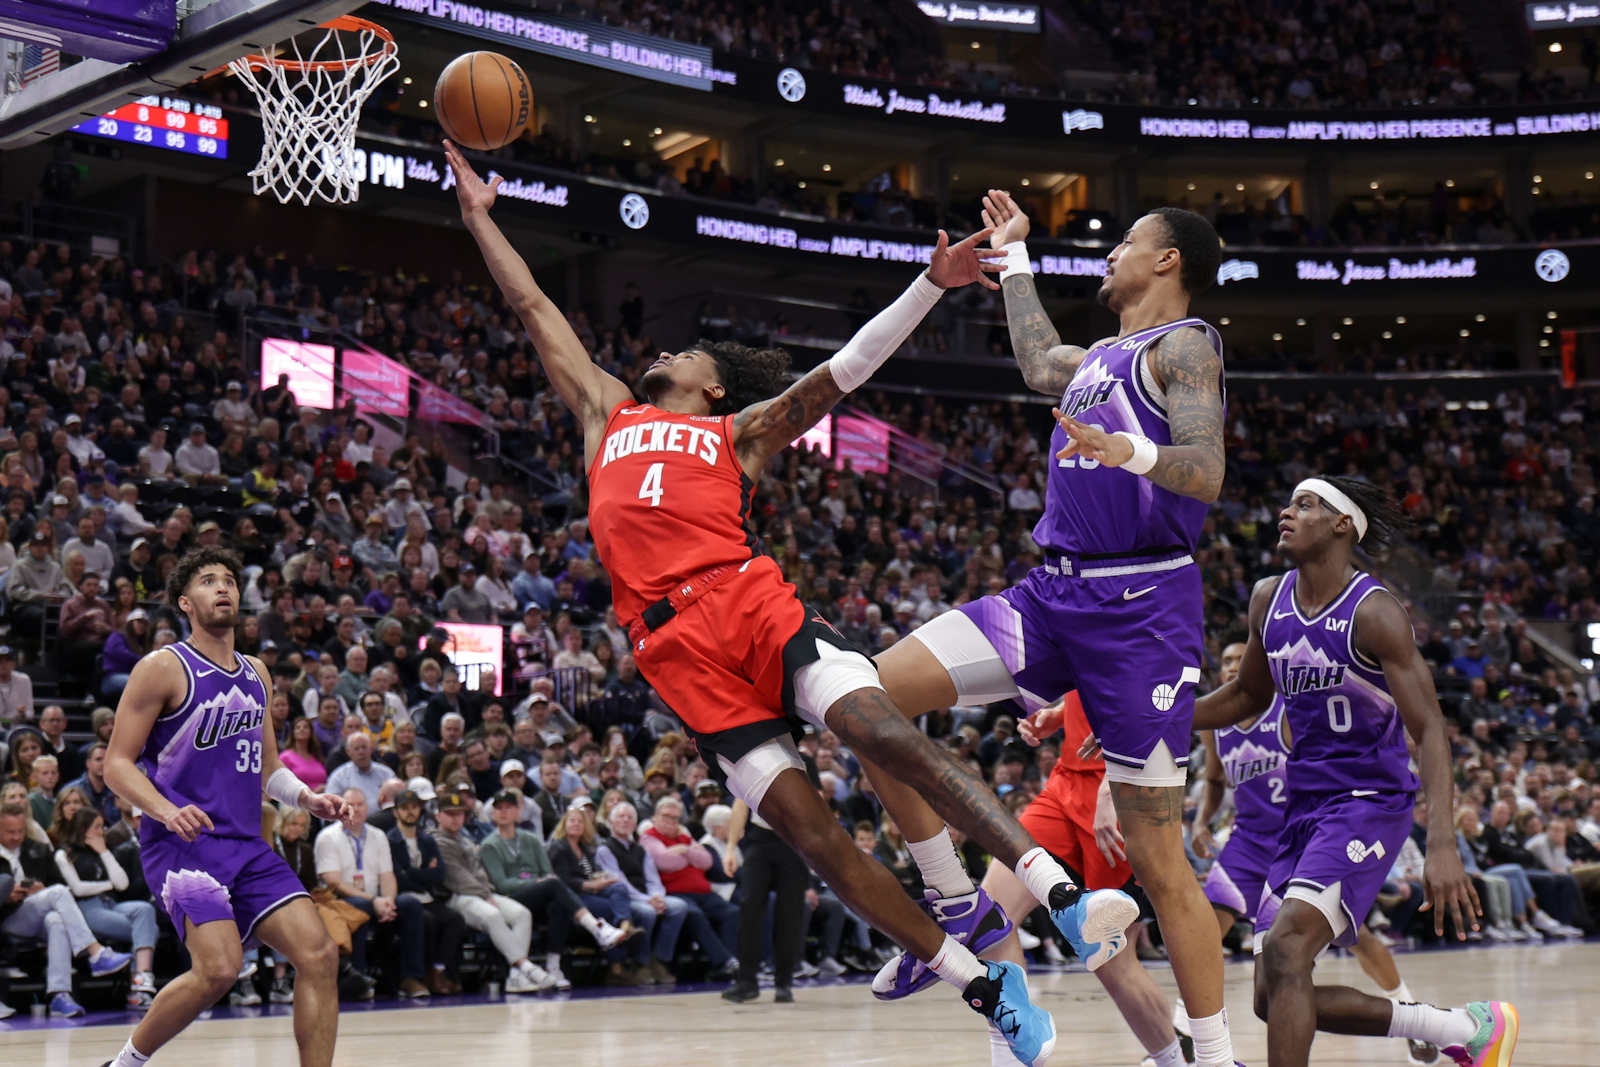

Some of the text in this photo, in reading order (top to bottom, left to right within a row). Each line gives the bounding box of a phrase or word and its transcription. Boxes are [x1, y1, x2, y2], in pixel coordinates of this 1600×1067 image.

[484, 10, 515, 36] HER
[515, 17, 588, 52] PRESENCE
[611, 40, 673, 72] BUILDING
[673, 55, 702, 79] HER
[509, 62, 530, 128] Wilson
[843, 84, 1006, 123] Utah Jazz Basketball
[98, 118, 217, 154] 20 23 95 99
[137, 105, 149, 121] 8
[166, 111, 186, 128] 99
[198, 117, 217, 134] 95
[1140, 116, 1218, 138] HONORING
[1218, 119, 1249, 139] HER
[1286, 120, 1377, 140] AMPLIFYING
[1377, 120, 1410, 140] HER
[1410, 117, 1491, 139] PRESENCE
[1516, 112, 1591, 136] BUILDING
[370, 151, 404, 189] PM
[696, 215, 769, 245] HONORING
[769, 226, 797, 249] HER
[830, 235, 914, 263] AMPLIFYING
[914, 245, 933, 265] HE
[1041, 255, 1108, 277] BUILDING
[1295, 256, 1477, 285] Utah Jazz Basketball
[1057, 379, 1125, 426] TAH
[601, 421, 721, 468] ROCKETS
[638, 462, 664, 507] 4
[1325, 616, 1349, 633] LVT
[1268, 658, 1349, 699] UTAH
[193, 706, 265, 750] UTAH
[1327, 695, 1352, 732] 0
[236, 739, 262, 774] 33
[1224, 755, 1280, 792] UTAH
[1268, 777, 1287, 803] 2
